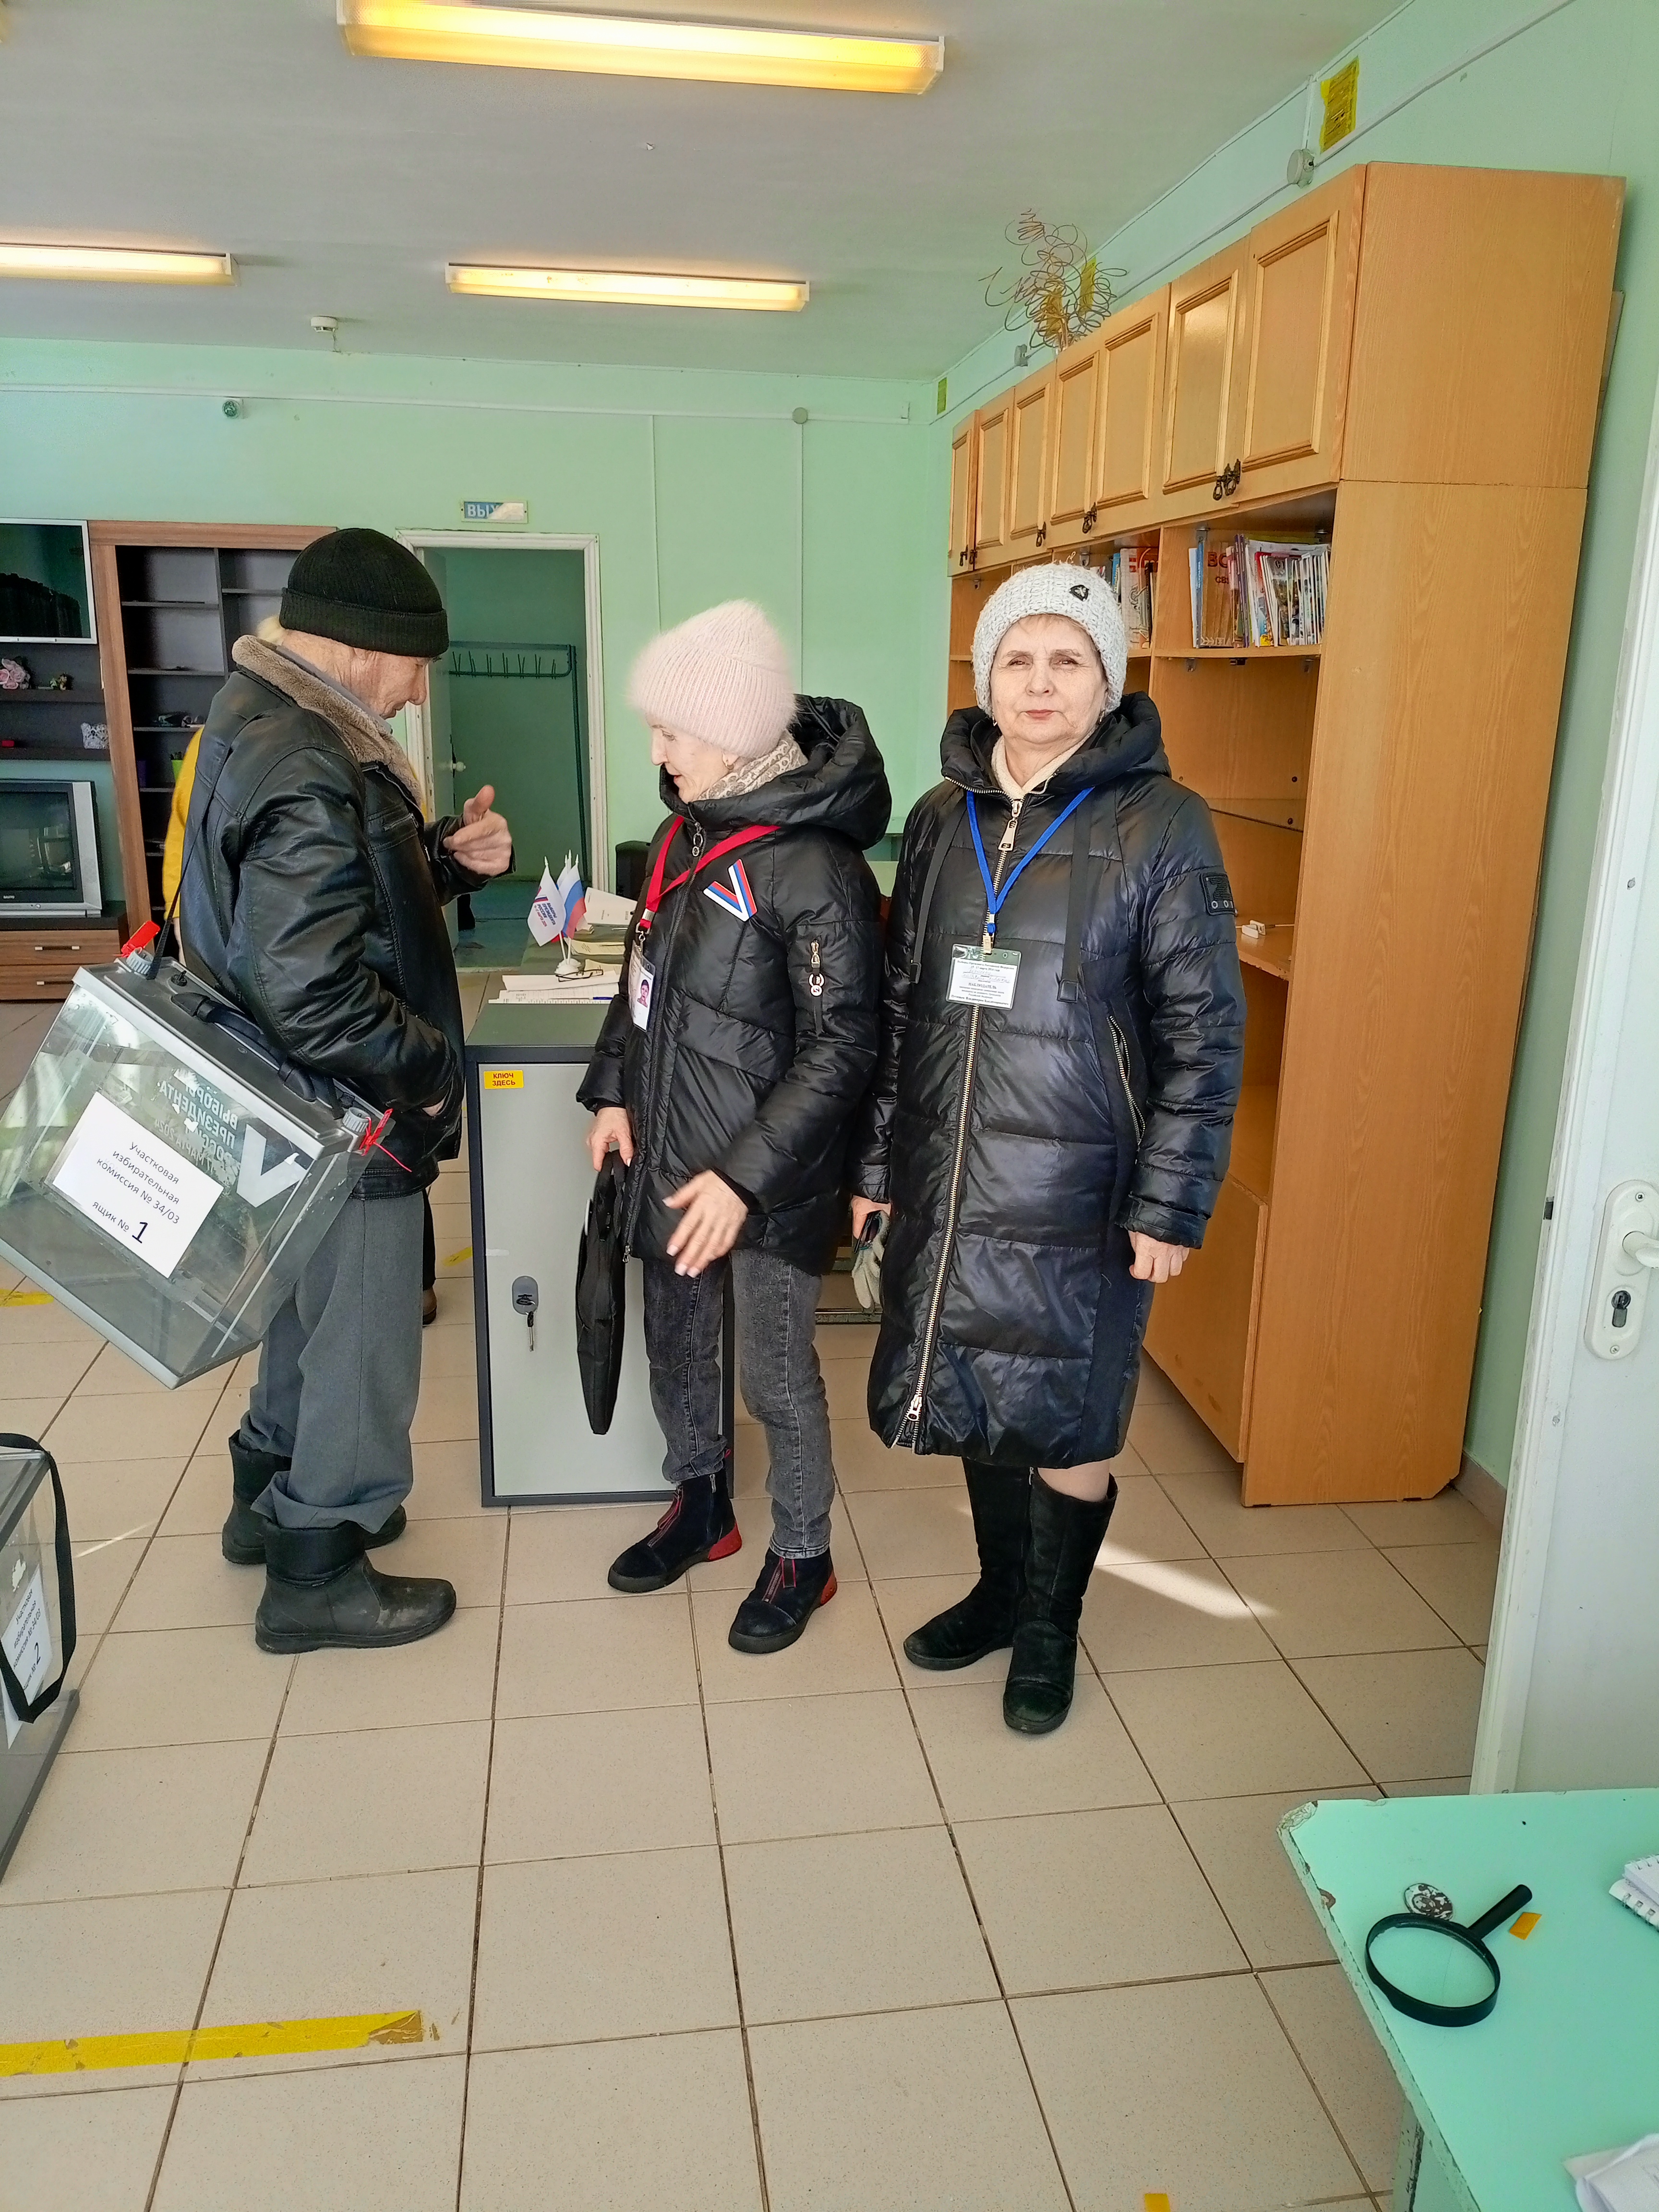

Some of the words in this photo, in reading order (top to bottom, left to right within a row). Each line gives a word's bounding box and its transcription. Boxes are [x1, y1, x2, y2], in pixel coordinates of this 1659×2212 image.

[112, 1151, 180, 1204] избирательная
[130, 1142, 179, 1184] Участковая
[97, 1158, 139, 1194] комиссия
[140, 1190, 152, 1204] №
[153, 1200, 180, 1224] 34/03
[92, 1202, 117, 1223] ящик
[118, 1219, 129, 1232] №
[132, 1221, 148, 1243] 1
[34, 1642, 41, 1665] 2
